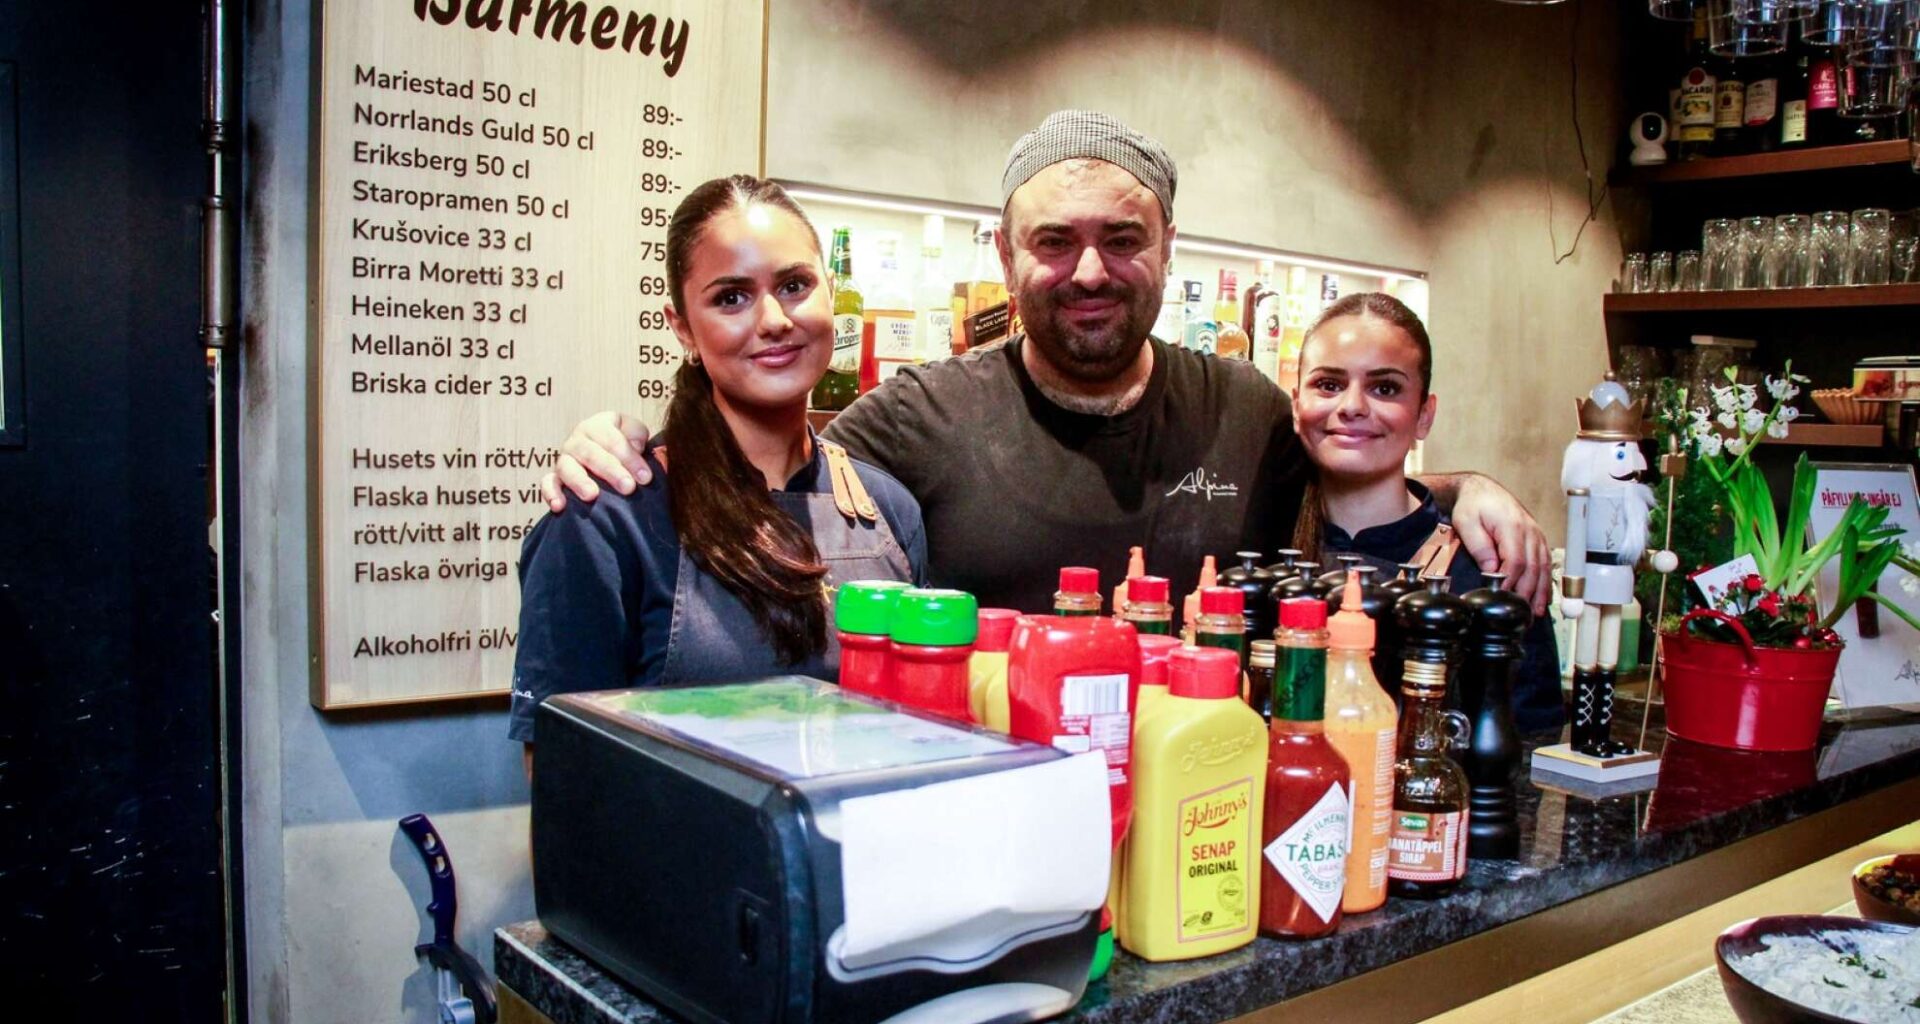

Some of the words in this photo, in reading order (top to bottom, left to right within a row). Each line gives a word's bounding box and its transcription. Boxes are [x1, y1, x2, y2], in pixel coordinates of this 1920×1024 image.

[355, 64, 473, 99] Mariestad
[483, 82, 510, 104] 50
[519, 88, 535, 107] cl
[643, 104, 682, 125] 89:-
[354, 102, 473, 136] Norrlands
[482, 120, 534, 143] Guld
[543, 126, 569, 147] 50
[577, 132, 593, 150] cl
[642, 138, 682, 160] 89:-
[354, 141, 467, 177] Eriksberg
[477, 154, 504, 176] 50
[513, 160, 529, 179] cl
[642, 173, 681, 194] 89:-
[353, 180, 507, 213] Staropramen
[517, 195, 544, 216] 50
[552, 200, 568, 218] cl
[353, 218, 469, 247] Krušovice
[478, 228, 505, 249] 33
[515, 232, 531, 251] cl
[641, 242, 666, 262] 75
[353, 256, 410, 280] Birra
[420, 261, 502, 285] Moretti
[512, 267, 538, 288] 33
[547, 271, 563, 289] cl
[352, 295, 464, 320] Heineken
[473, 301, 501, 322] 33
[510, 304, 526, 323] cl
[352, 333, 451, 357] Mellanöl
[460, 338, 488, 358] 33
[497, 340, 514, 359] cl
[640, 345, 678, 364] 59:-
[352, 372, 426, 393] Briska
[435, 374, 492, 395] cider
[500, 376, 526, 395] 33
[535, 377, 551, 396] cl
[353, 448, 435, 469] Husets
[443, 448, 476, 468] vin
[485, 446, 560, 468] rött/vit
[354, 486, 428, 507] Flaska
[437, 485, 510, 505] husets
[354, 522, 445, 545] rött/vitt
[453, 521, 480, 542] alt
[355, 561, 429, 583] Flaska
[438, 557, 507, 581] övriga
[354, 630, 470, 658] Alkoholfri
[479, 627, 517, 651] öl/v
[1184, 793, 1248, 837] Johnny's
[1191, 840, 1236, 862] SENAP
[1285, 840, 1345, 862] TABAS
[1399, 851, 1426, 865] SIRAP
[1188, 860, 1238, 878] ORIGINAL
